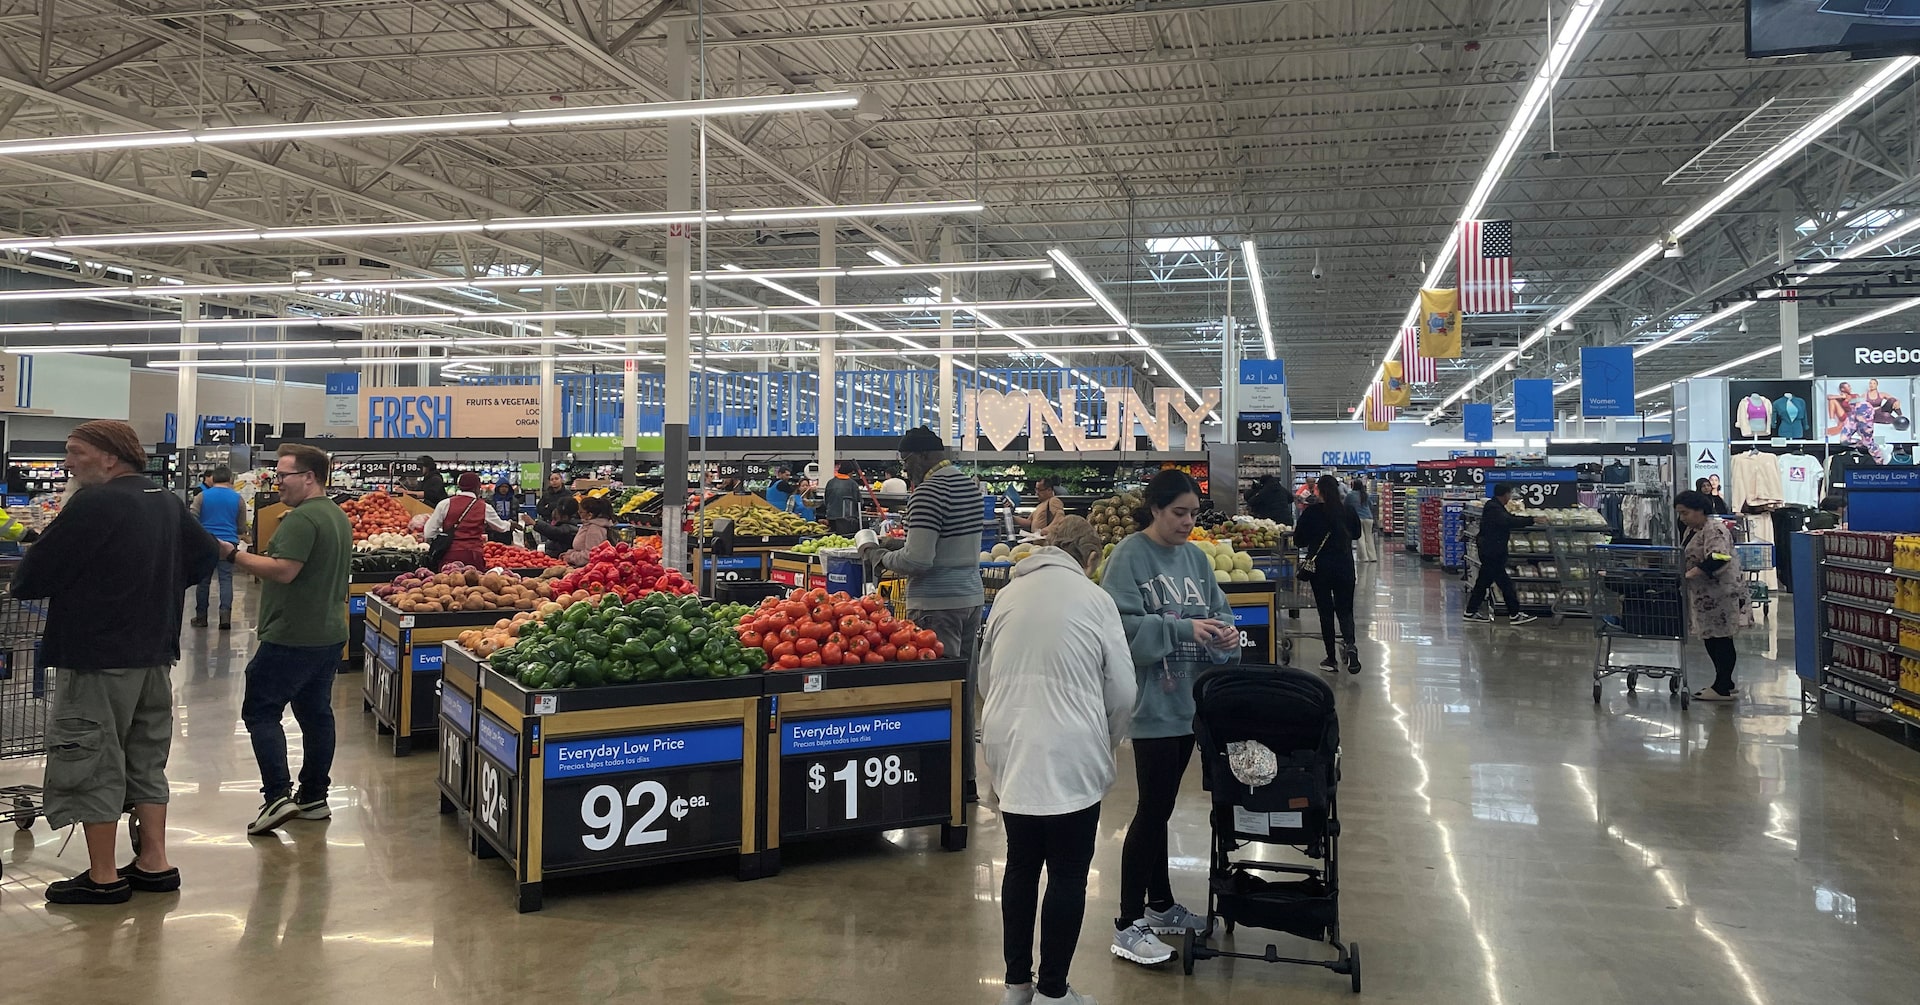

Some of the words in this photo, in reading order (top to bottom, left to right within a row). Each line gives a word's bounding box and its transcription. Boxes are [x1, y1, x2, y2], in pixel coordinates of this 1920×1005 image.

[1855, 347, 1920, 364] Reebo
[1268, 373, 1278, 381] A3
[466, 398, 492, 406] FRUITS
[501, 398, 540, 406] VEGETABL
[1589, 397, 1617, 405] Women
[368, 395, 452, 439] FRESH
[525, 408, 540, 416] LOC
[515, 418, 540, 426] ORGAN
[1322, 451, 1372, 466] CREAMER
[523, 469, 541, 483] Organic
[1438, 469, 1457, 483] $37
[1467, 467, 1484, 484] $6
[1852, 472, 1889, 481] Everyday
[1891, 472, 1907, 480] Low
[1446, 504, 1463, 513] PEP
[420, 654, 442, 664] Ever
[793, 723, 846, 739] Everyday
[848, 722, 871, 734] Low
[873, 719, 901, 732] Price
[558, 743, 620, 761] Everyday
[623, 741, 650, 755] Low
[653, 738, 685, 752] Price
[793, 740, 815, 749] Precios
[816, 738, 832, 747] bajos
[832, 736, 849, 745] todos
[558, 762, 585, 772] Precios
[585, 760, 604, 770] bajos
[604, 758, 625, 767] todos
[625, 757, 636, 765] los
[903, 769, 918, 783] lb.
[689, 794, 710, 808] ea.
